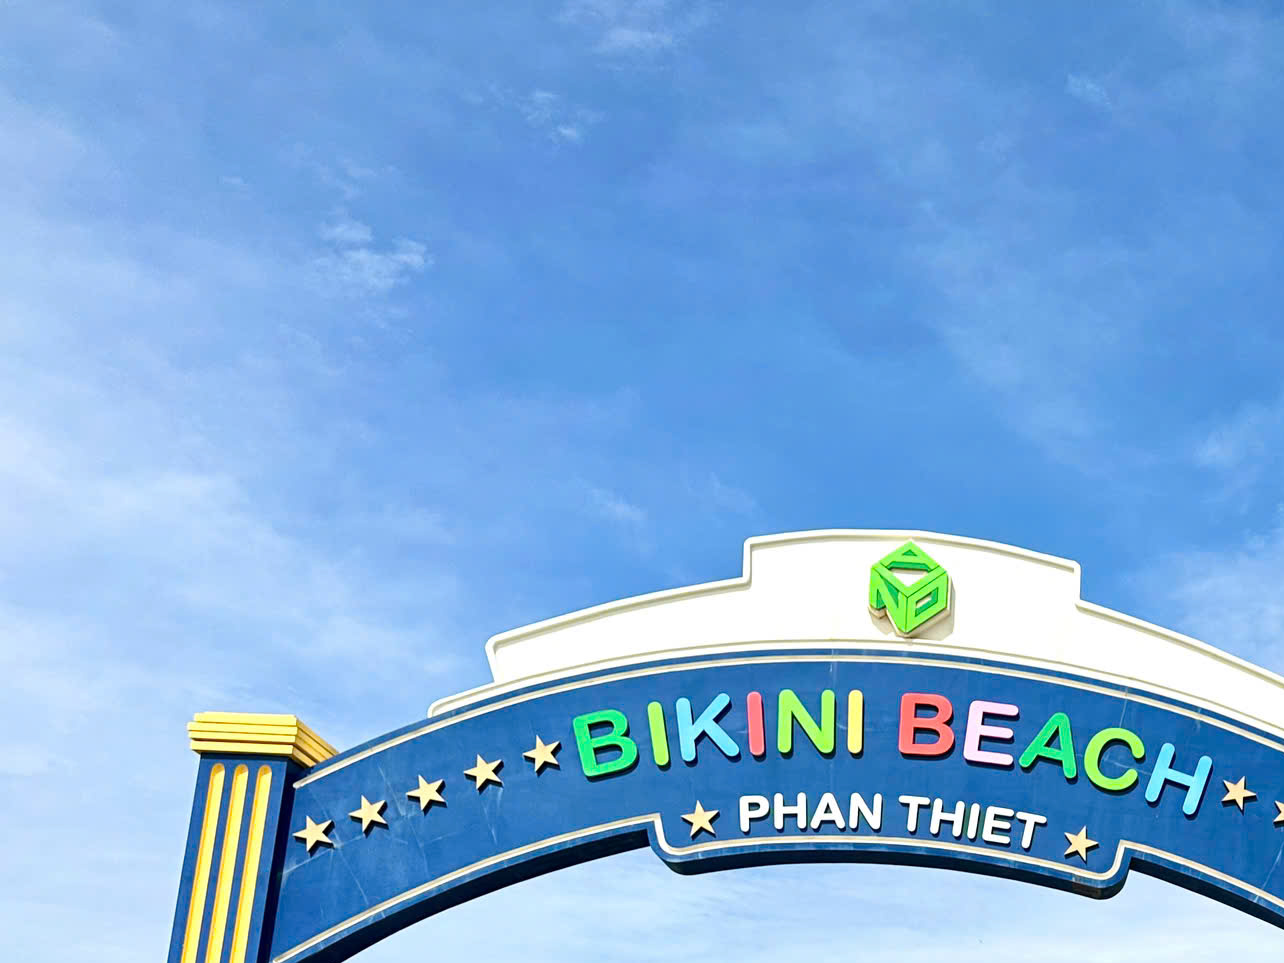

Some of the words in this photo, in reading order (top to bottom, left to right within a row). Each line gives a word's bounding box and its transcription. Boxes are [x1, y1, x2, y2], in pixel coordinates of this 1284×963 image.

[573, 689, 864, 777] BIKINI
[898, 692, 1213, 815] BEACH
[739, 792, 884, 833] PHAN
[898, 795, 1047, 849] THIET
